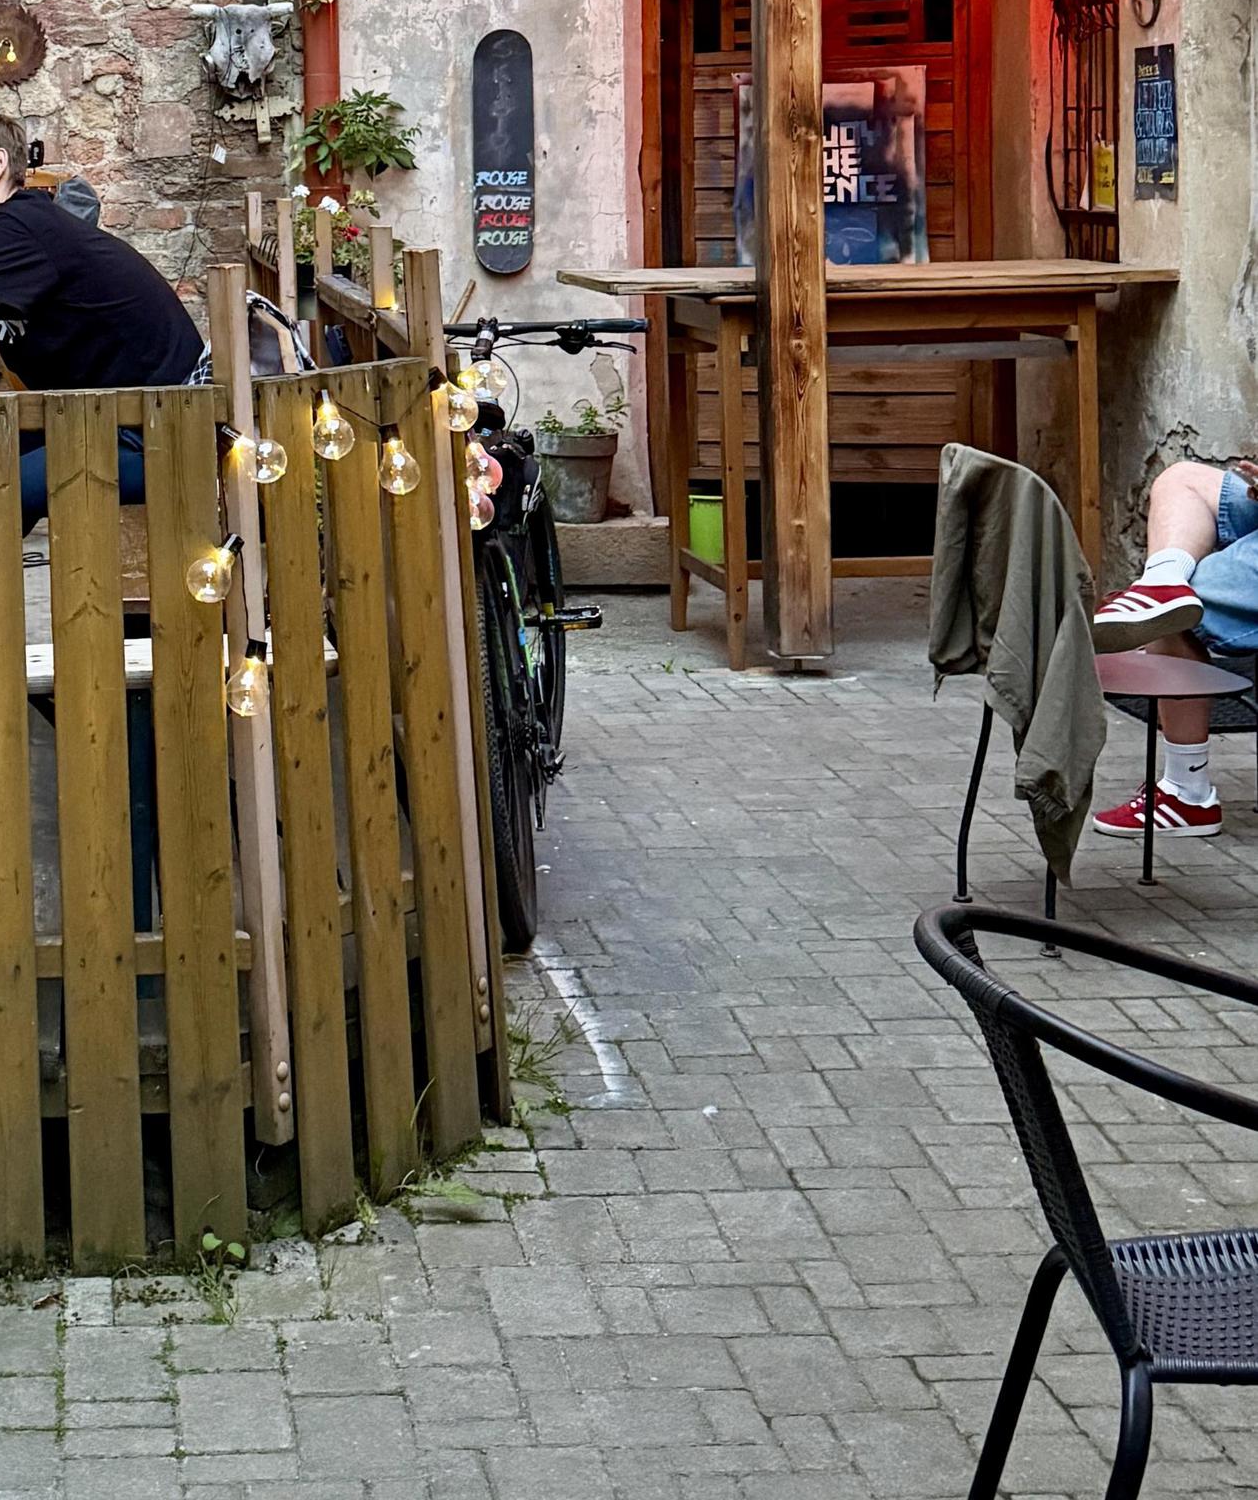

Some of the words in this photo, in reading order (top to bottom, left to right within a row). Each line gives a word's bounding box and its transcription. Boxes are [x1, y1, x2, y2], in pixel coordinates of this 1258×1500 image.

[822, 121, 879, 148] JOY
[822, 148, 862, 177] HE
[475, 170, 528, 186] ROUGE
[823, 174, 897, 203] ENCE
[479, 194, 532, 210] ROUGE
[477, 230, 529, 246] ROUGE
